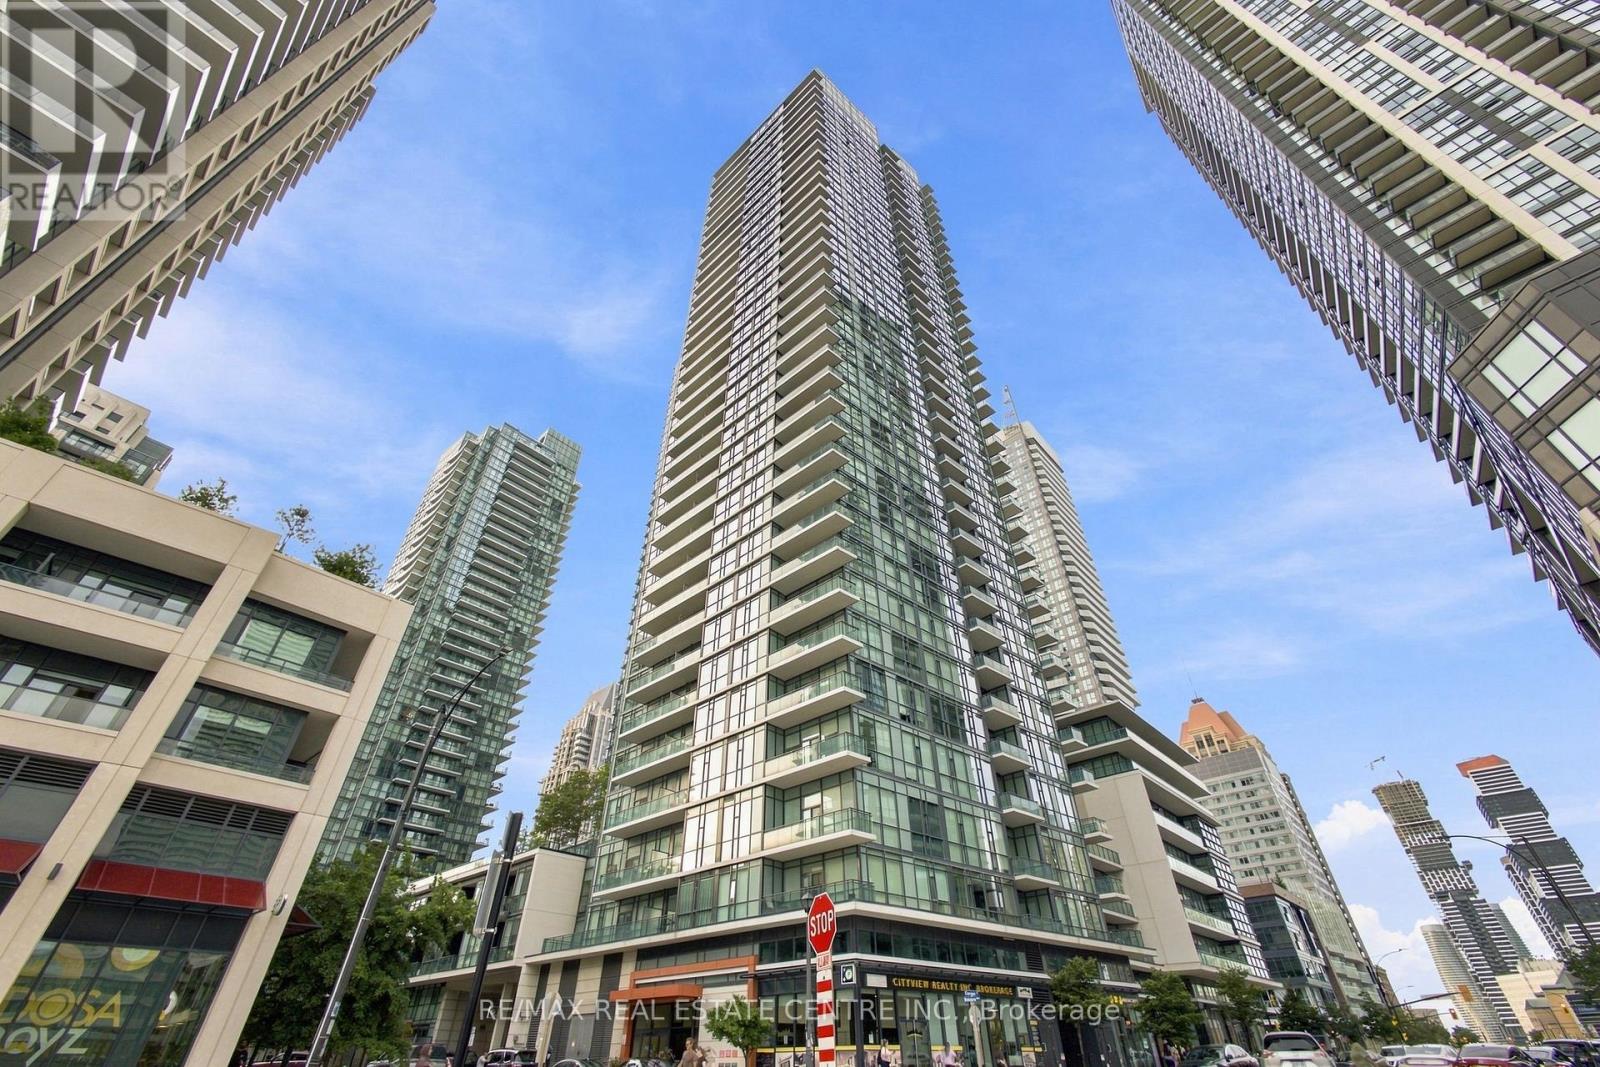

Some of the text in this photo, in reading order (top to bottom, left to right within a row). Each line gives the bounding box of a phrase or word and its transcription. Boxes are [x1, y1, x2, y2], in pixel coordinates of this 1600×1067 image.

[810, 909, 834, 937] STOP
[892, 977, 929, 988] CITYVIEW
[932, 980, 957, 991] REALTY
[976, 984, 1014, 995] BROKERAGE
[0, 986, 121, 1028] DOSA
[0, 1026, 89, 1067] oyz
